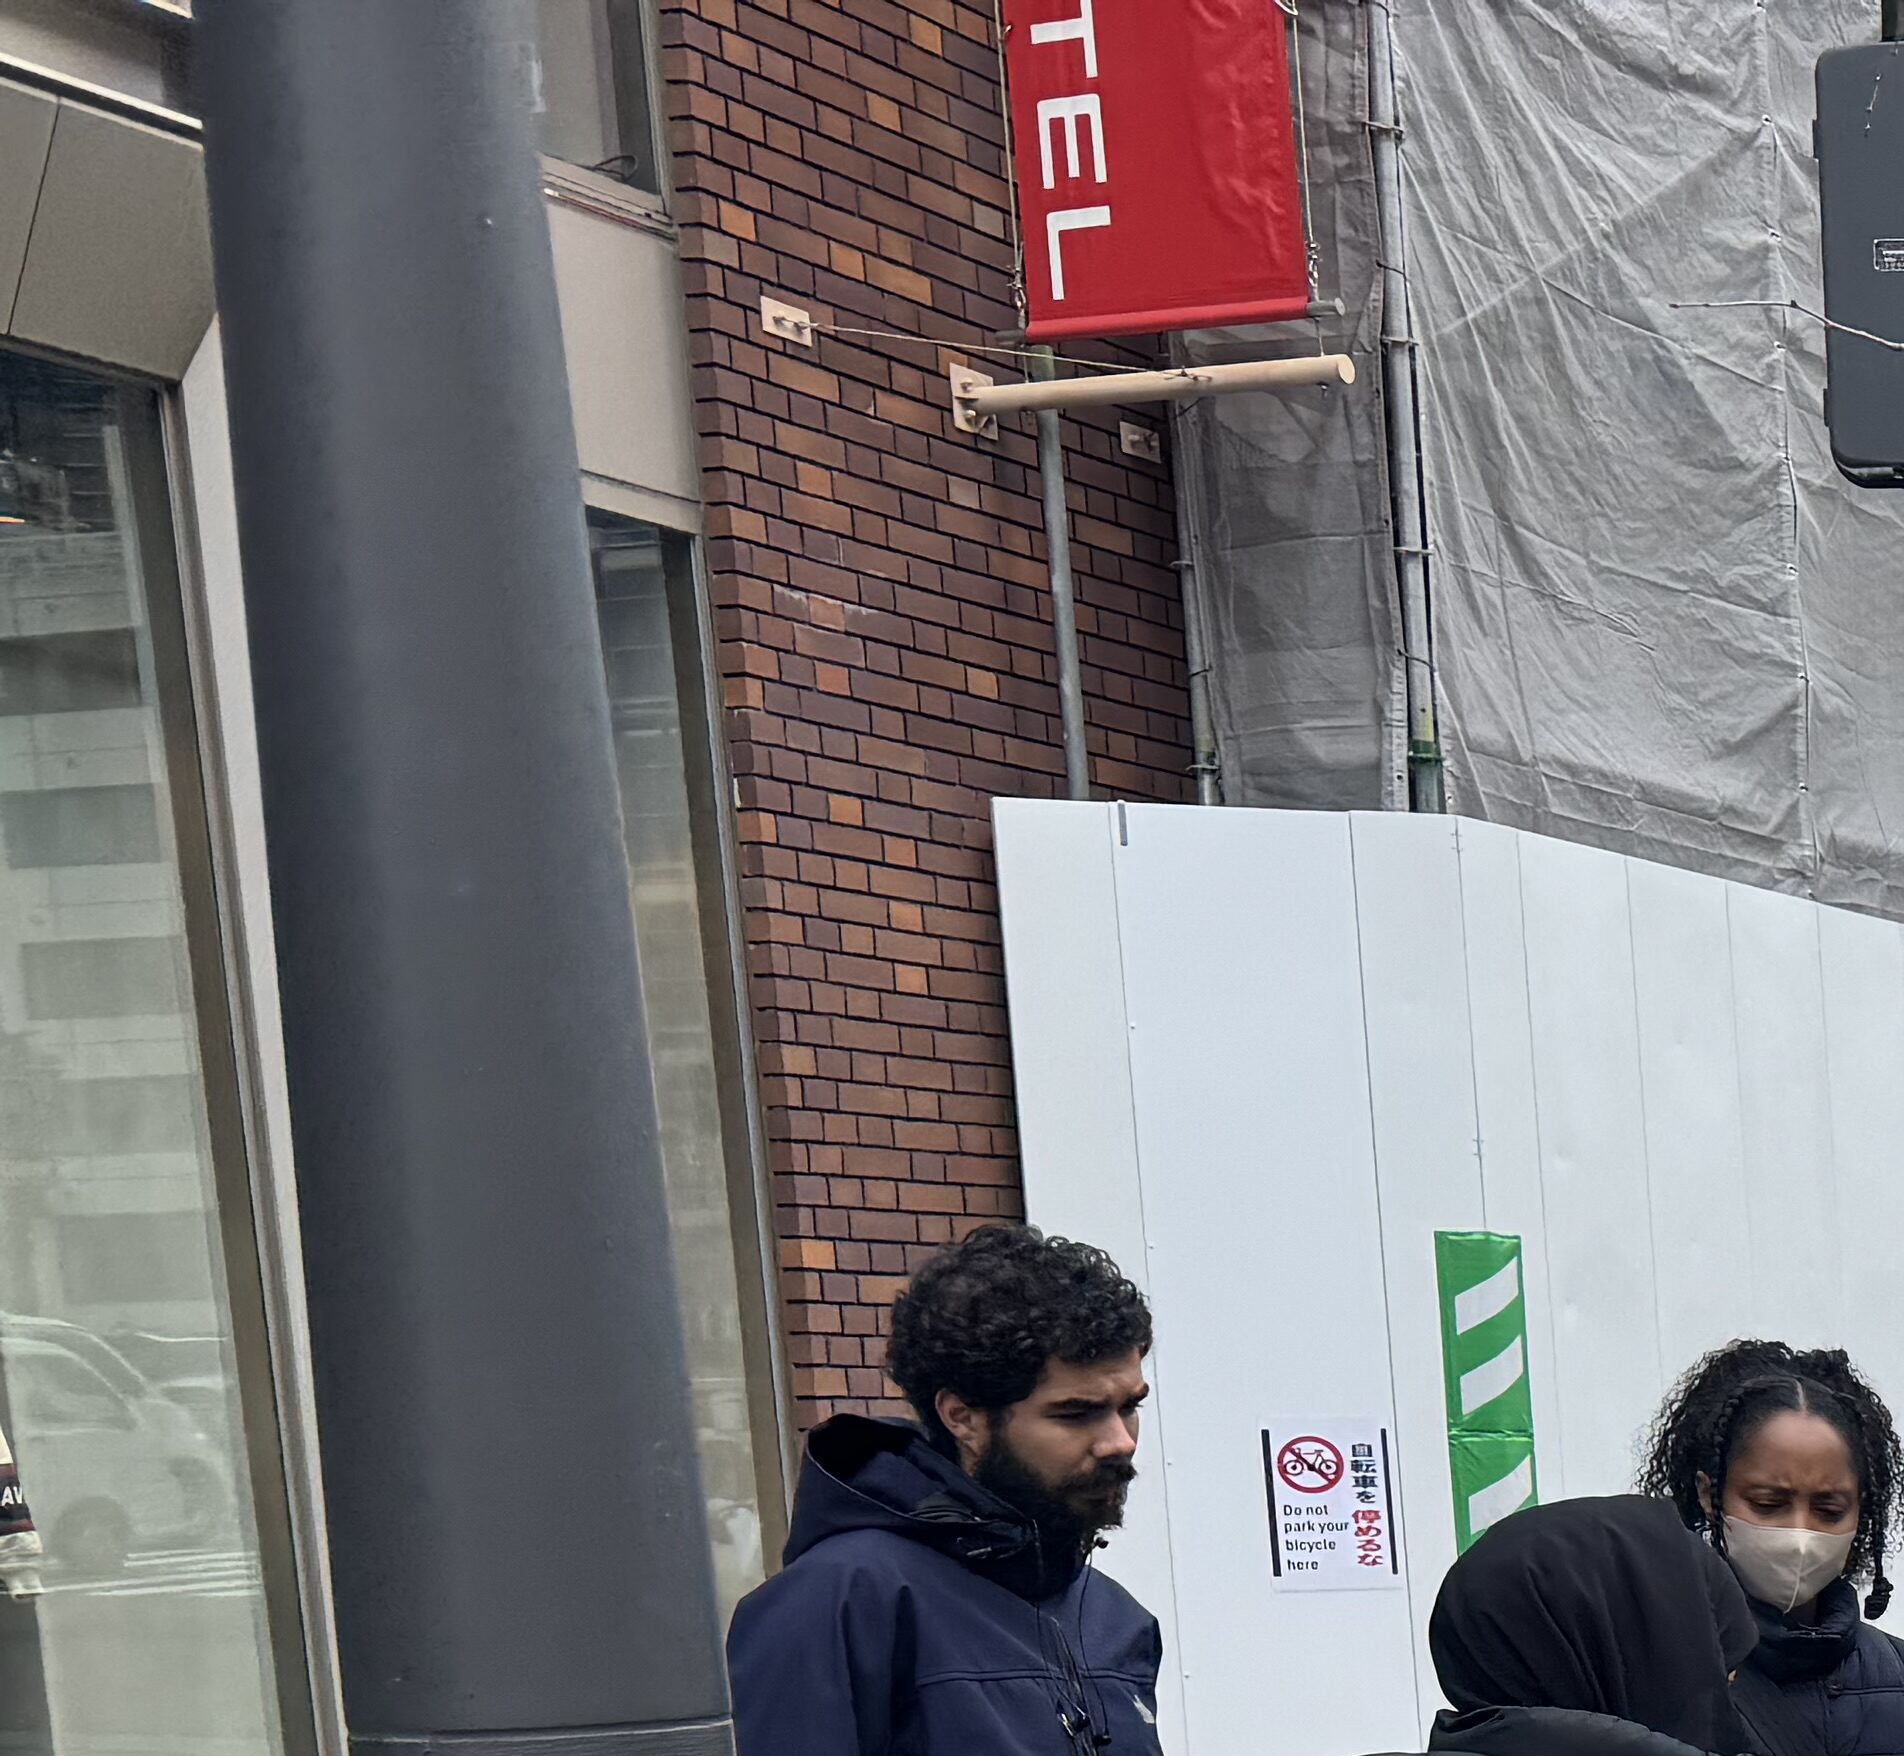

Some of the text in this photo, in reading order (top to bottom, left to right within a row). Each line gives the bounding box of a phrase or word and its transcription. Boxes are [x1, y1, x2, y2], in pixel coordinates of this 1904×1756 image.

[1030, 0, 1111, 301] TEL
[1283, 1504, 1329, 1516] Do not
[1284, 1521, 1349, 1534] park your
[1285, 1538, 1336, 1553] bicycle
[1287, 1559, 1319, 1571] here
